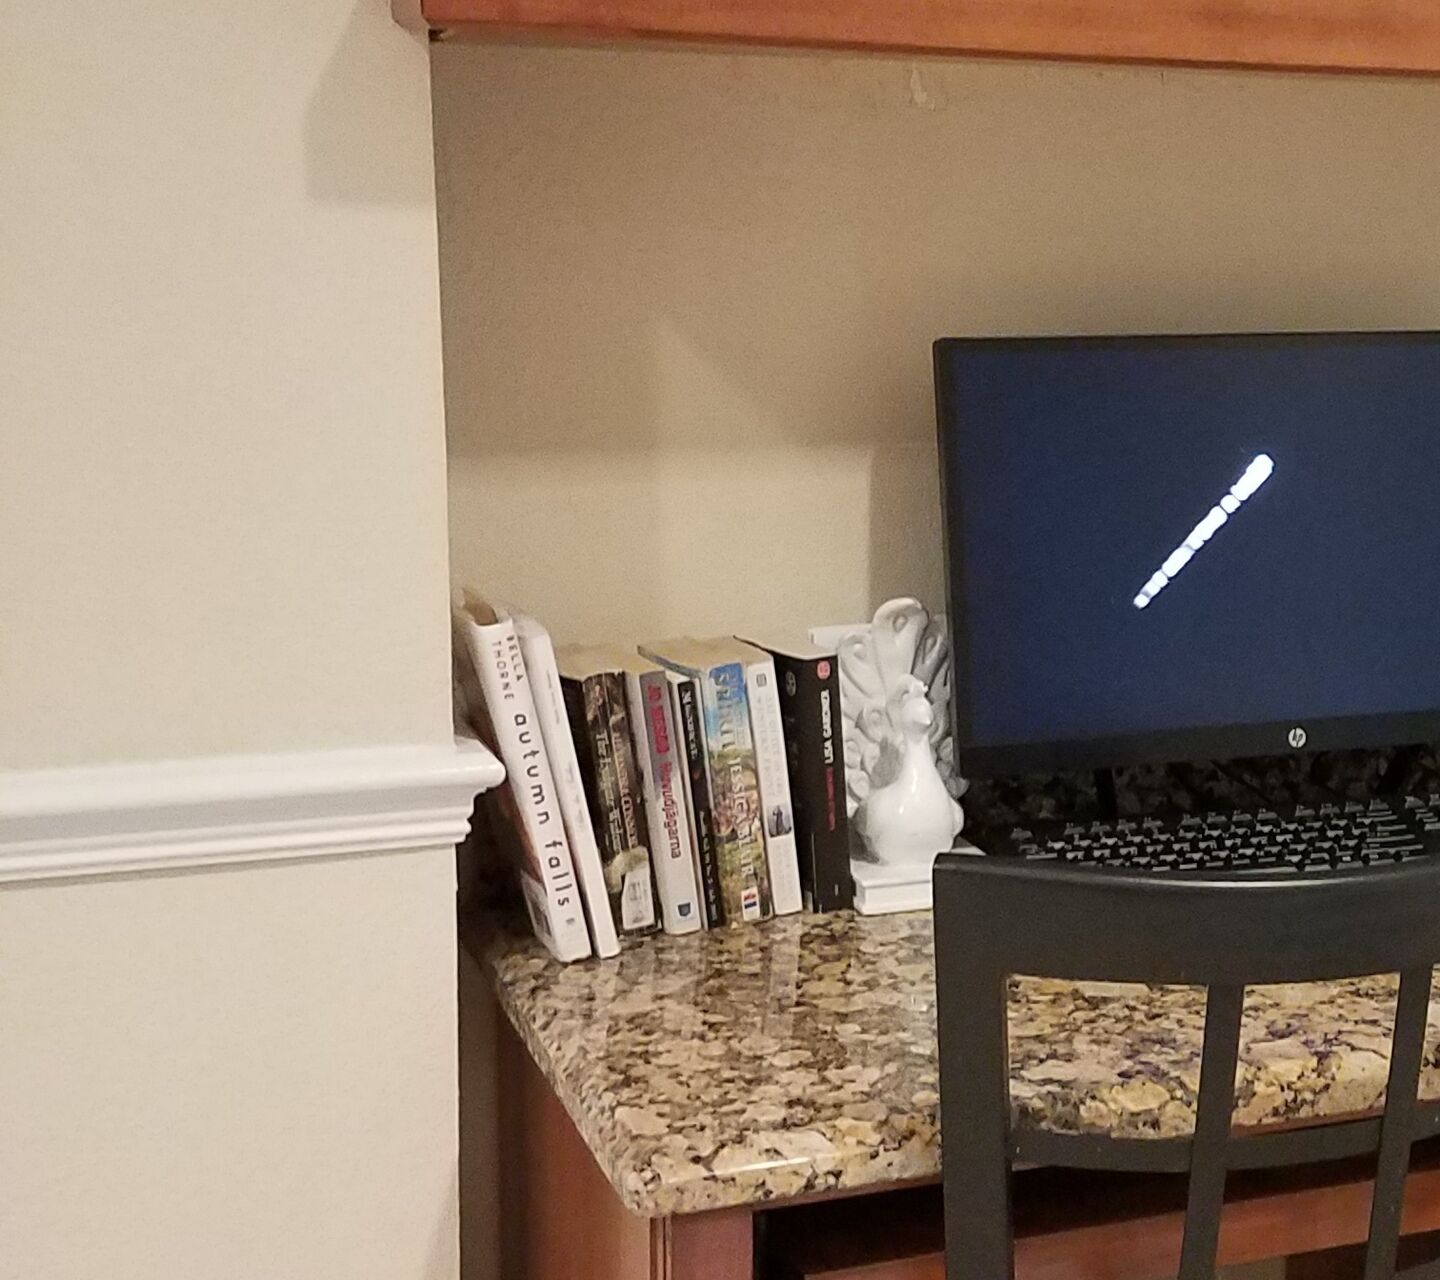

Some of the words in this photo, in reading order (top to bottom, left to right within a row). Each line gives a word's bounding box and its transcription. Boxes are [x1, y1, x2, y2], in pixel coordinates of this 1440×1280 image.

[491, 640, 515, 700] THORNE
[506, 634, 525, 681] BELLA
[1291, 728, 1305, 748] hp
[513, 712, 552, 825] autumn
[543, 839, 574, 907] falls
[728, 757, 750, 830] JESSICA
